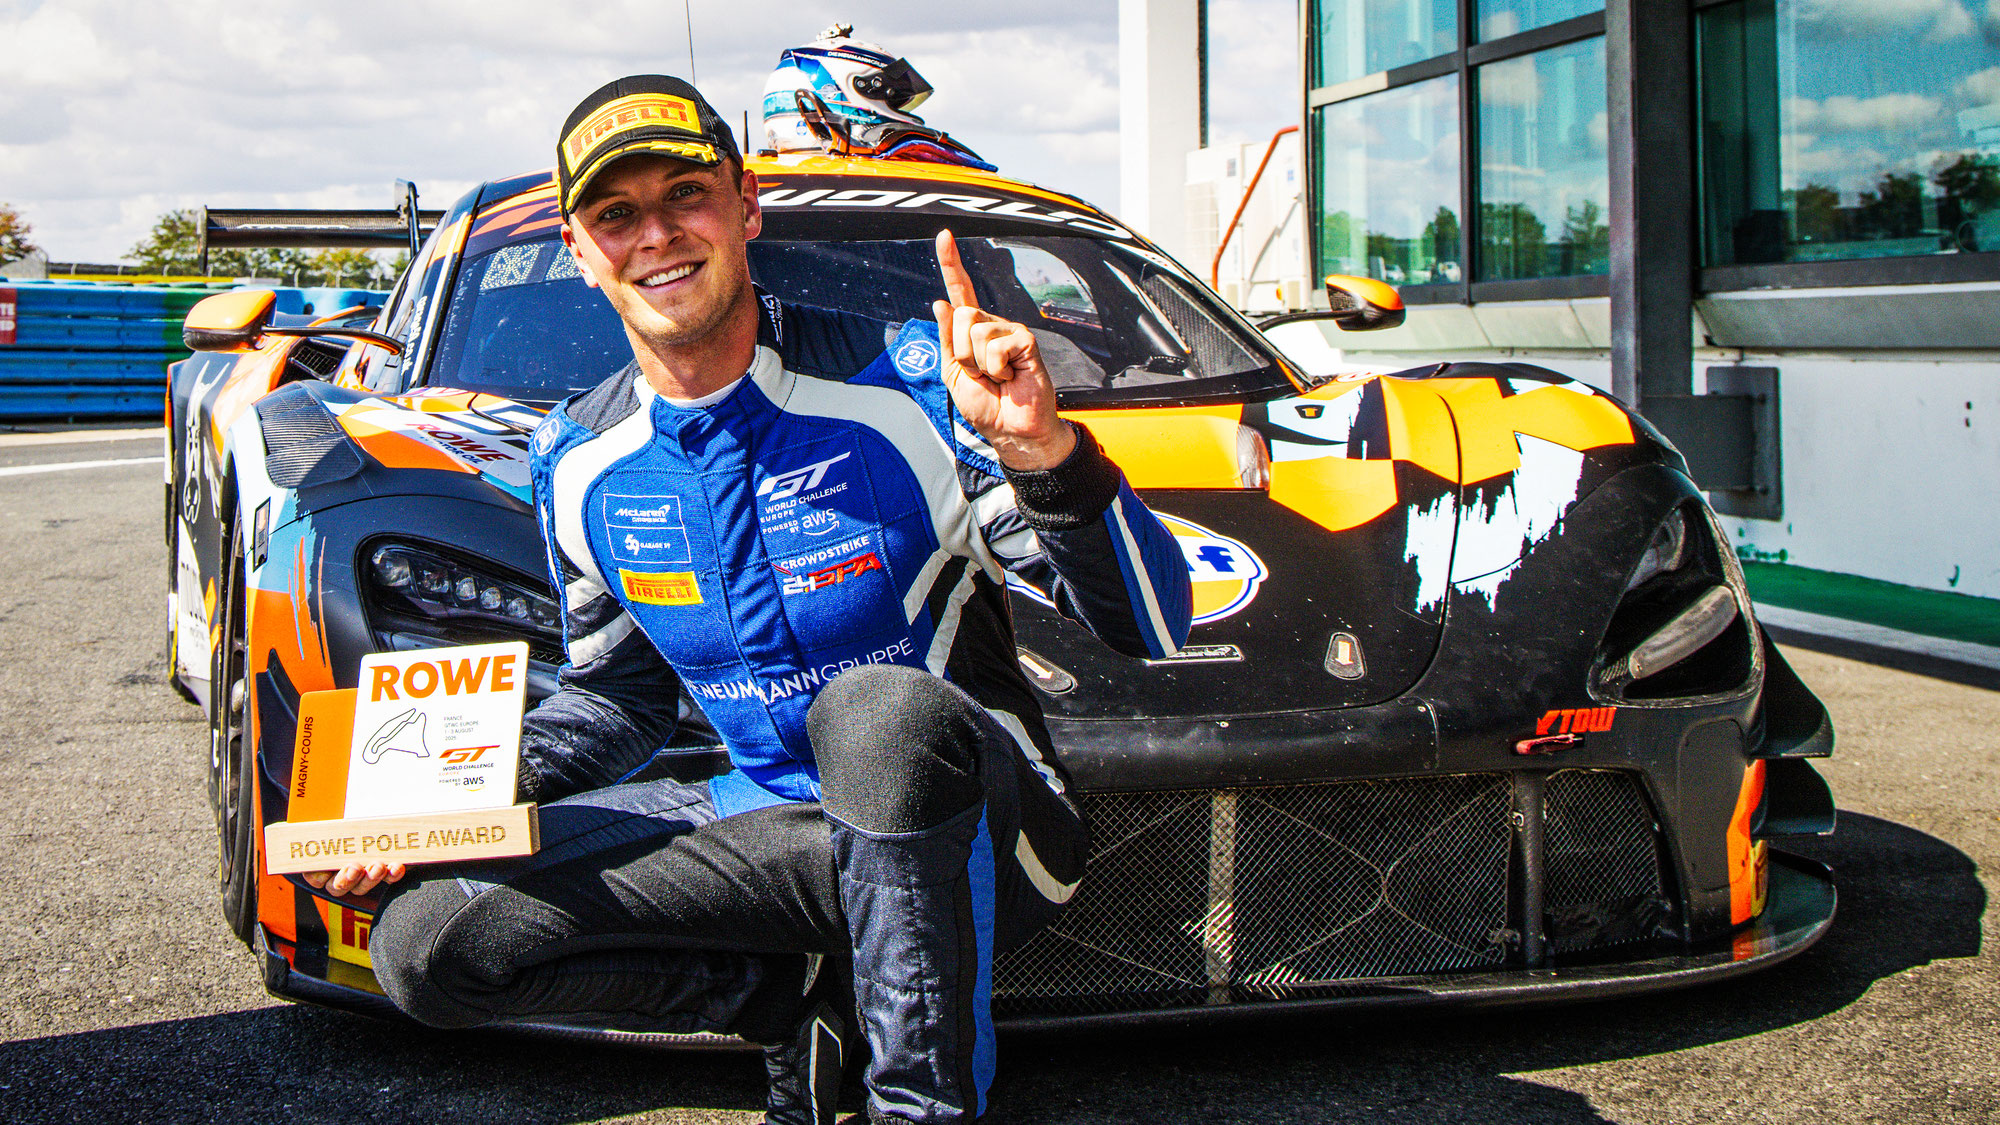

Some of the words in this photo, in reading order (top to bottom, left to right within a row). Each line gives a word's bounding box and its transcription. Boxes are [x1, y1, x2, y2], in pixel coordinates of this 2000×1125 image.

[570, 99, 688, 159] PIRELLI
[902, 349, 931, 368] 21
[405, 424, 516, 462] ROWE
[756, 451, 851, 502] GT
[615, 508, 667, 517] McLaren
[765, 499, 797, 514] WORLD
[799, 482, 848, 504] CHALLENGE
[760, 509, 795, 523] EUROPE
[762, 520, 799, 534] POWERED
[802, 508, 836, 529] aws
[781, 536, 870, 570] CROWDSTRIKE
[626, 576, 693, 599] PIRELLI
[368, 654, 516, 702] ROWE
[1559, 707, 1618, 734] TOW
[297, 716, 314, 798] MAGNY-COURS
[439, 745, 501, 764] GT
[463, 776, 485, 785] aws
[290, 837, 357, 859] ROWE
[362, 831, 420, 853] POLE
[426, 825, 507, 848] AWARD
